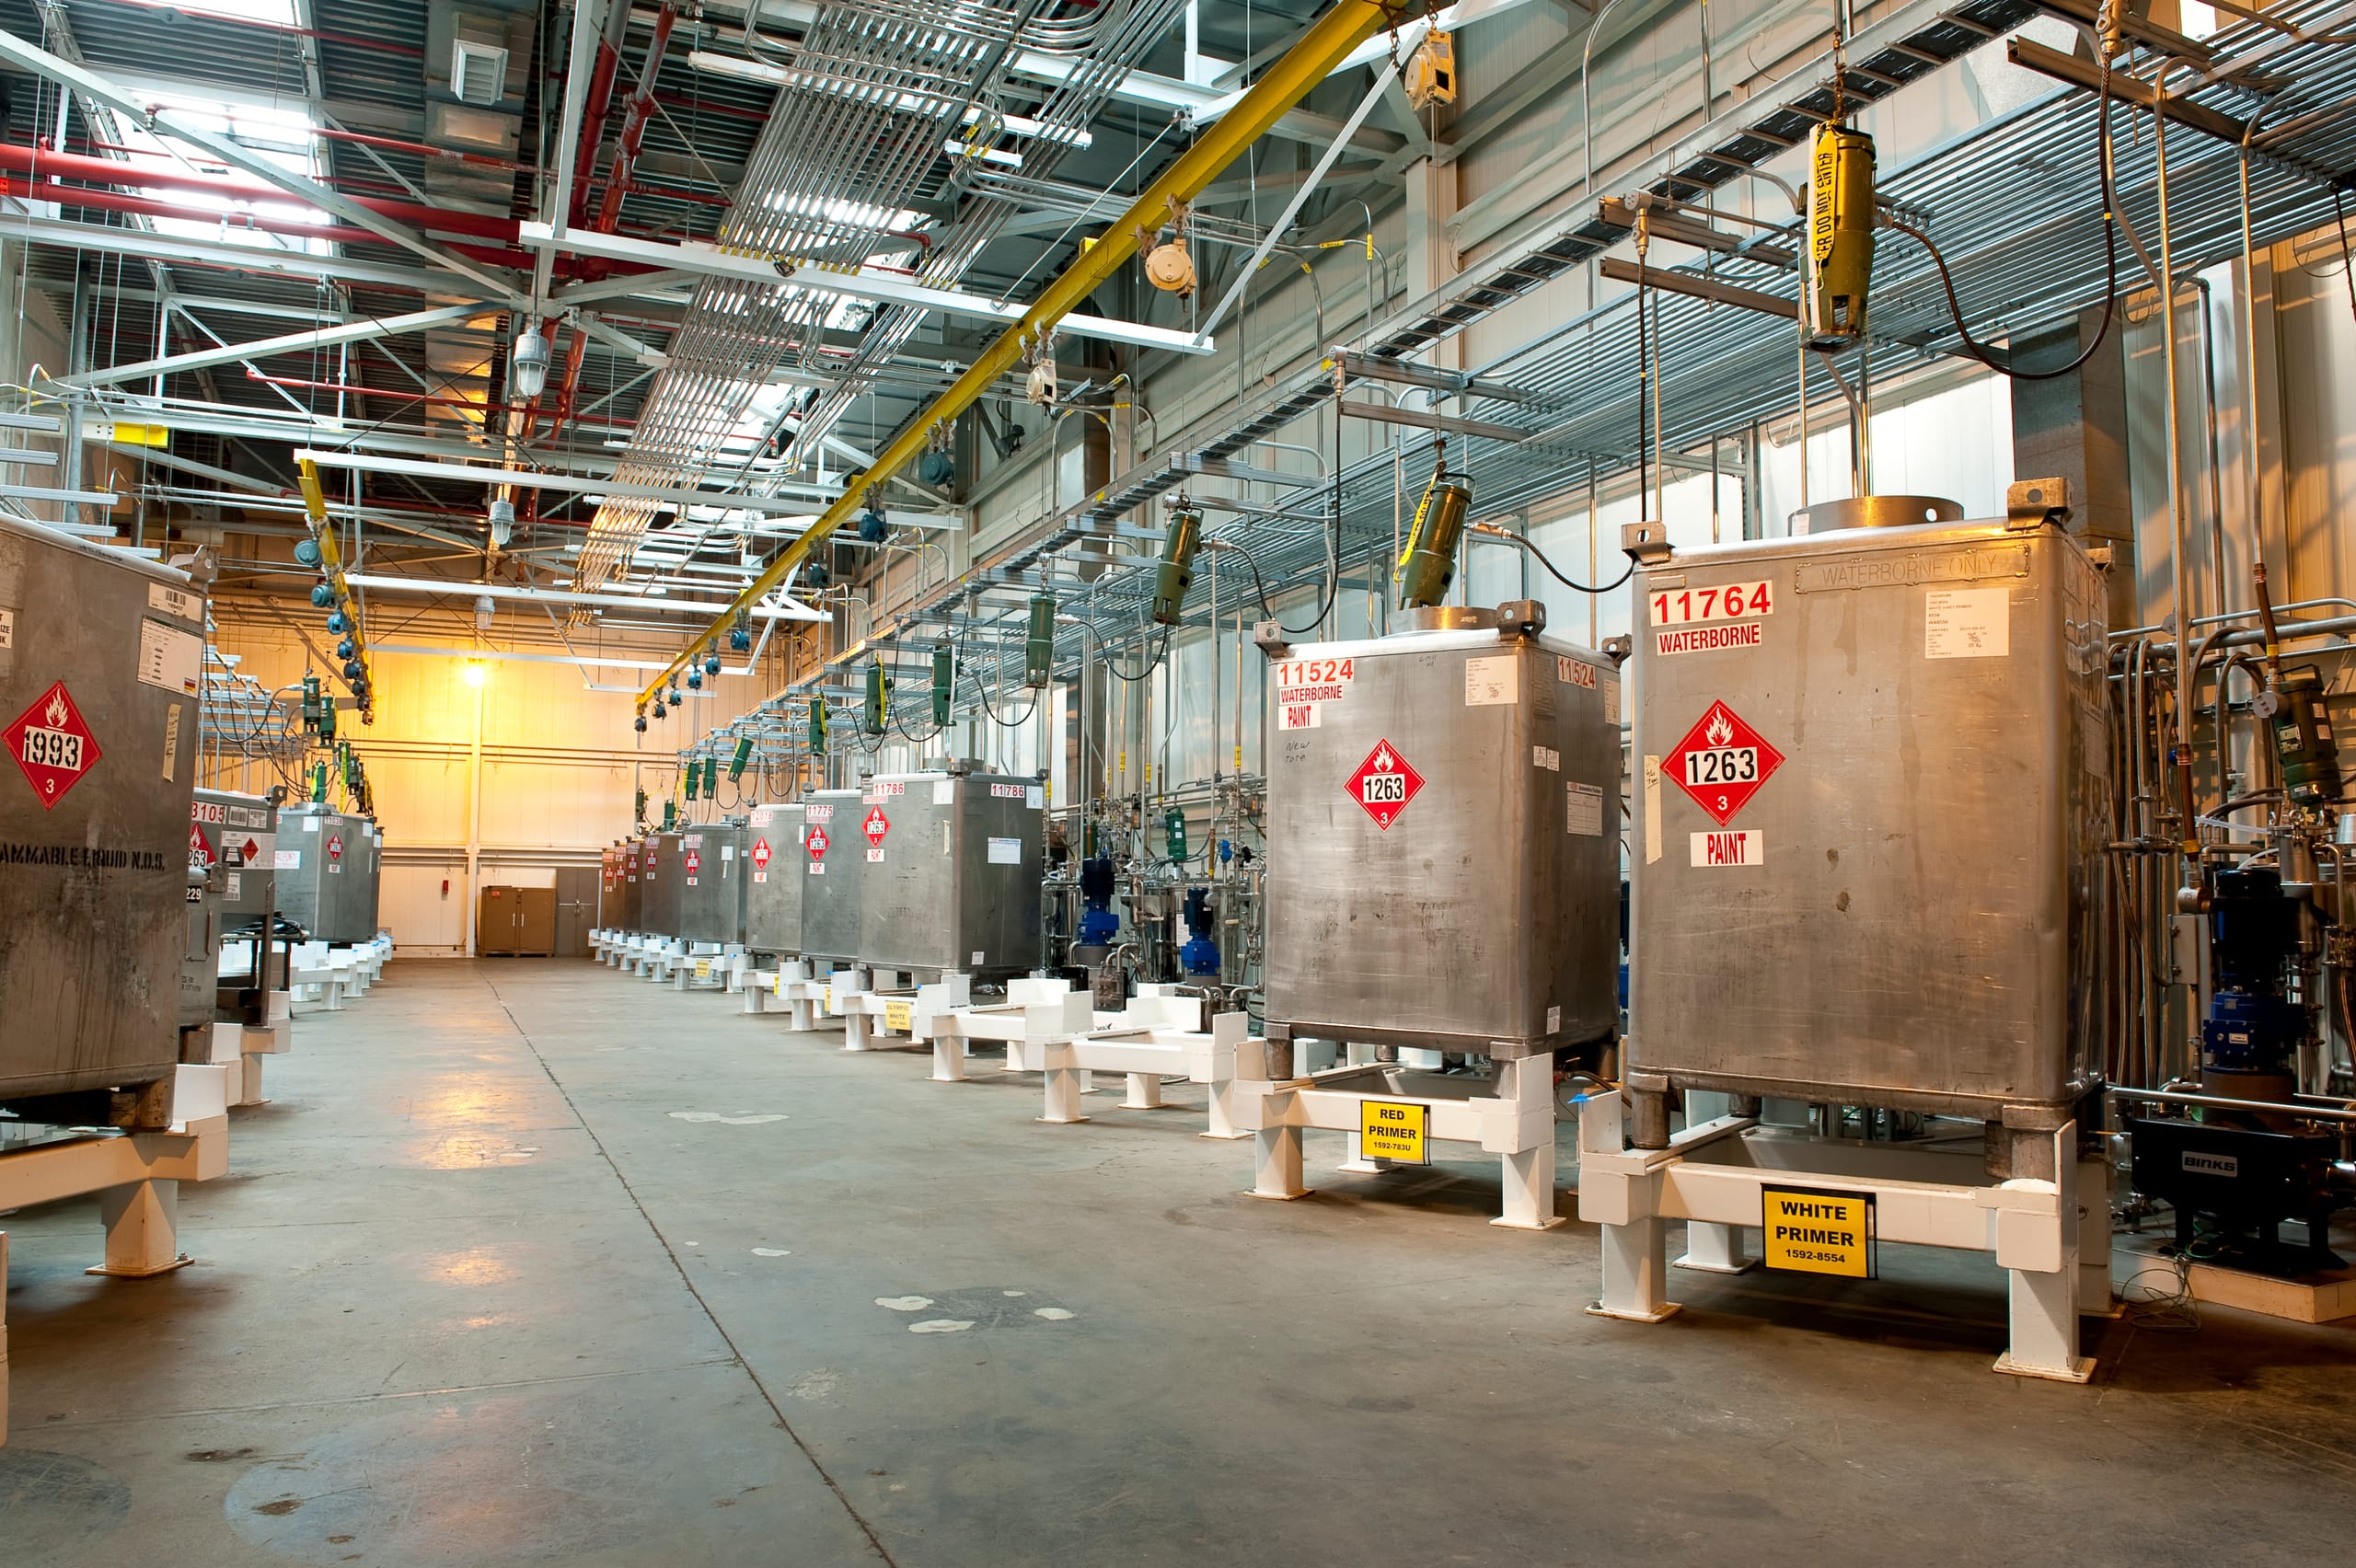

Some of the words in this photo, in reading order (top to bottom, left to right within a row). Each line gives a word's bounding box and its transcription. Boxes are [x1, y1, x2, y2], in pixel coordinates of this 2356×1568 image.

[1816, 215, 1831, 235] DO
[1822, 560, 1944, 586] WATERBORNE
[1949, 553, 1998, 576] ONLY
[1654, 582, 1771, 623] 11764
[1659, 624, 1761, 653] WATERBORNE
[1280, 659, 1353, 686] 11524
[1559, 657, 1595, 688] 11524
[1281, 685, 1343, 703] WATERBORNE
[1288, 705, 1311, 729] PAINT
[25, 731, 79, 767] 1993
[1688, 750, 1755, 783] 1263
[45, 778, 55, 793] 3
[874, 783, 904, 795] 11786
[992, 785, 1024, 797] 11786
[1365, 777, 1403, 801] 1263
[807, 805, 833, 817] 11775
[1717, 796, 1728, 811] 3
[868, 822, 884, 834] 1263
[1380, 812, 1388, 824] 3
[1707, 833, 1747, 865] PAINT
[1380, 1108, 1405, 1121] RED
[1369, 1125, 1416, 1139] PRIMER
[1781, 1201, 1847, 1221] WHITE
[1776, 1226, 1854, 1247] PRIMER
[1785, 1249, 1846, 1263] 1592-8554
